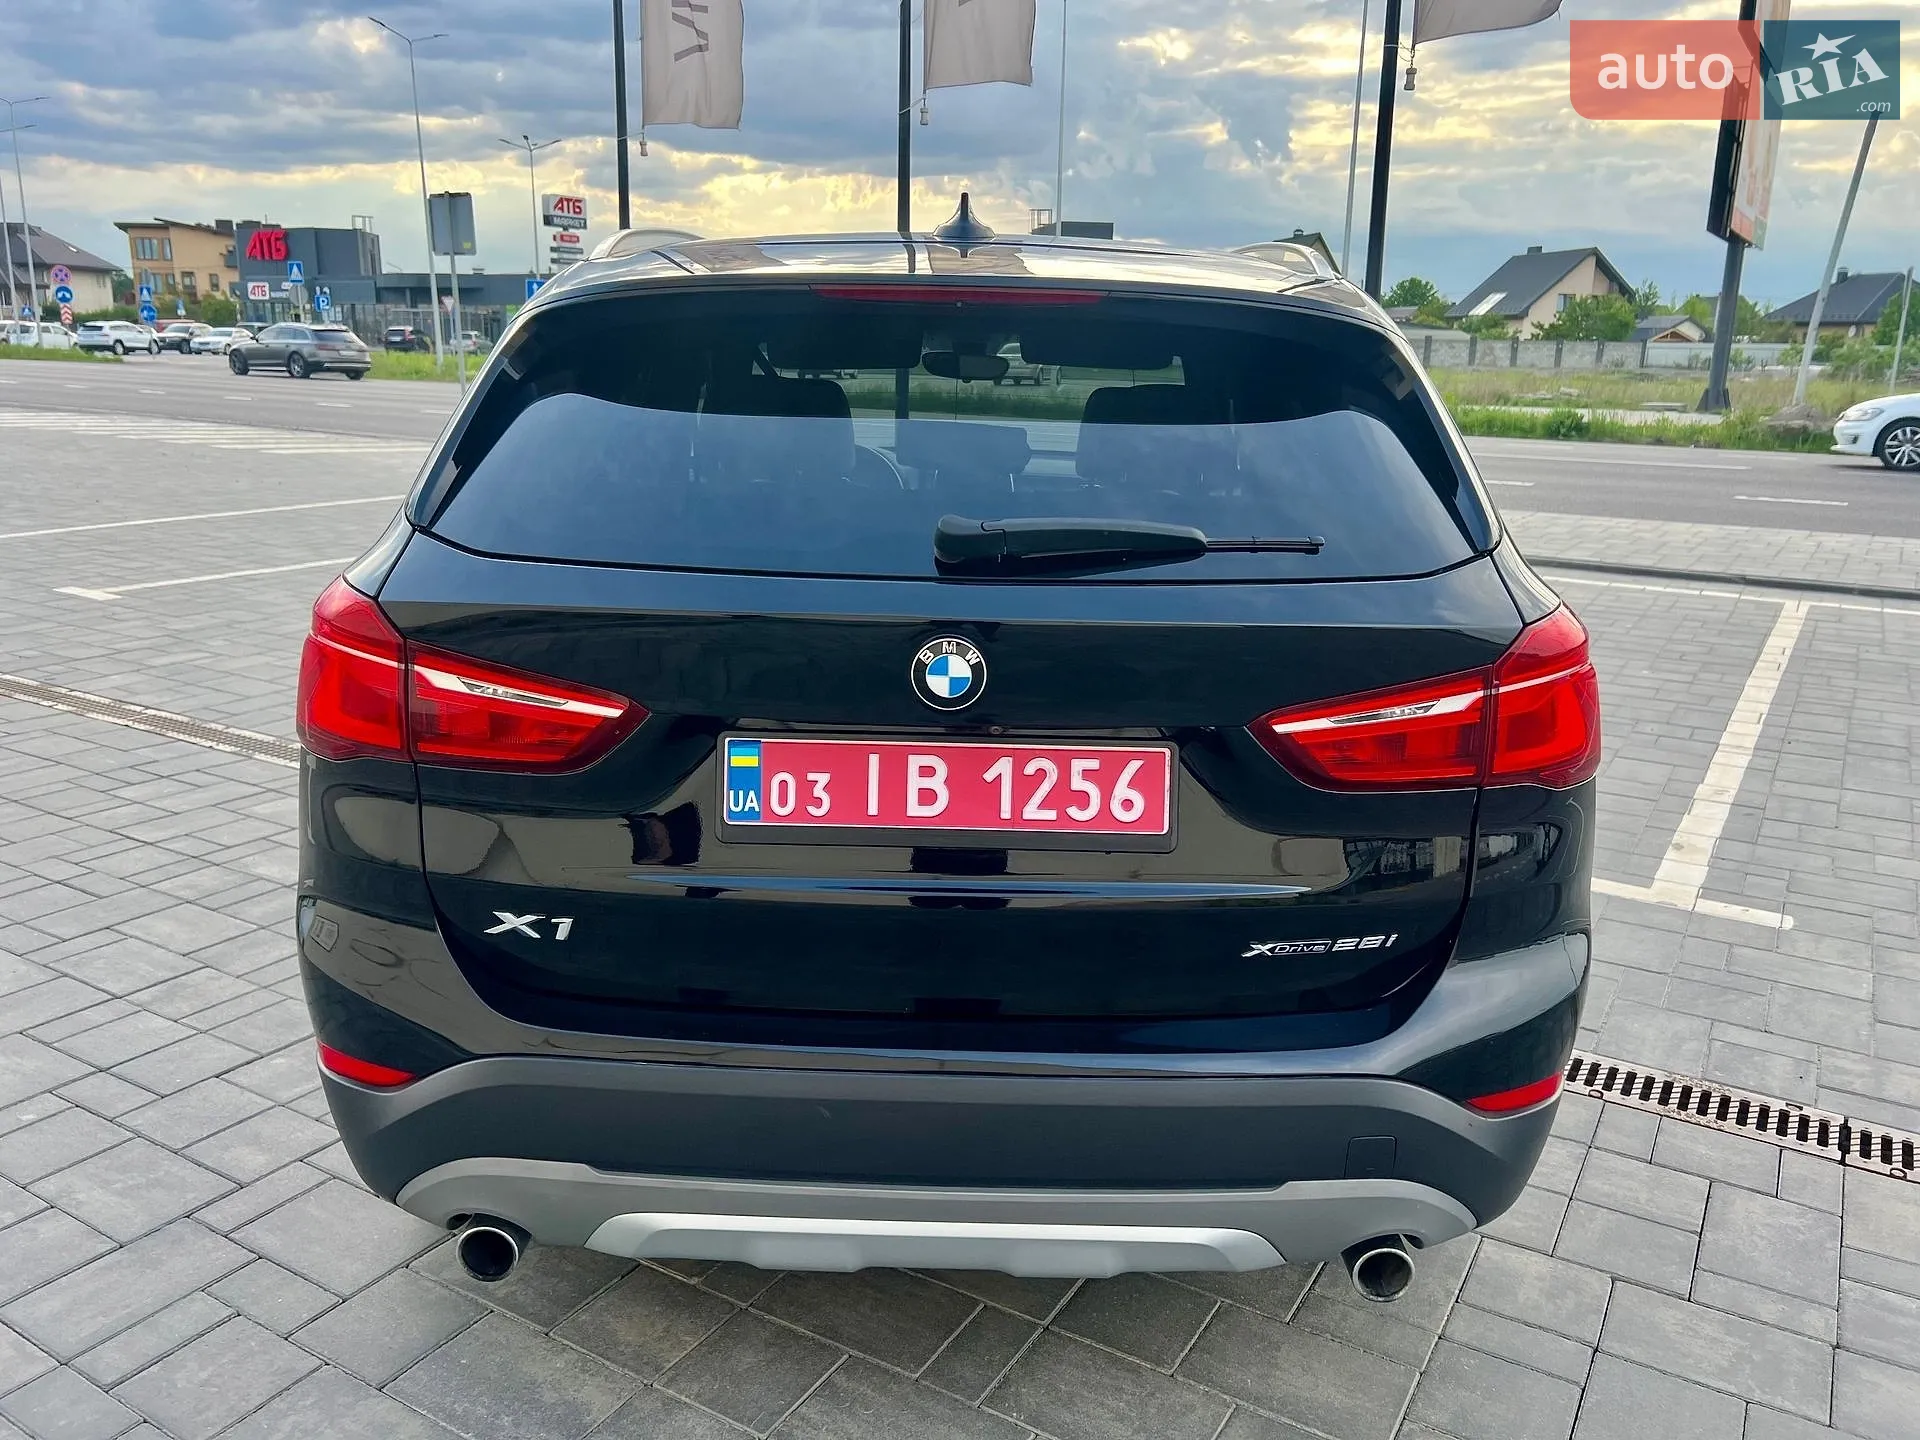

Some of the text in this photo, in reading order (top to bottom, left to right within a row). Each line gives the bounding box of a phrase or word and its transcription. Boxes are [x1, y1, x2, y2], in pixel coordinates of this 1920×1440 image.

[919, 641, 981, 666] BMW
[729, 789, 760, 812] UA
[769, 771, 832, 818] 03
[982, 756, 1145, 824] 1256
[483, 910, 574, 941] X1
